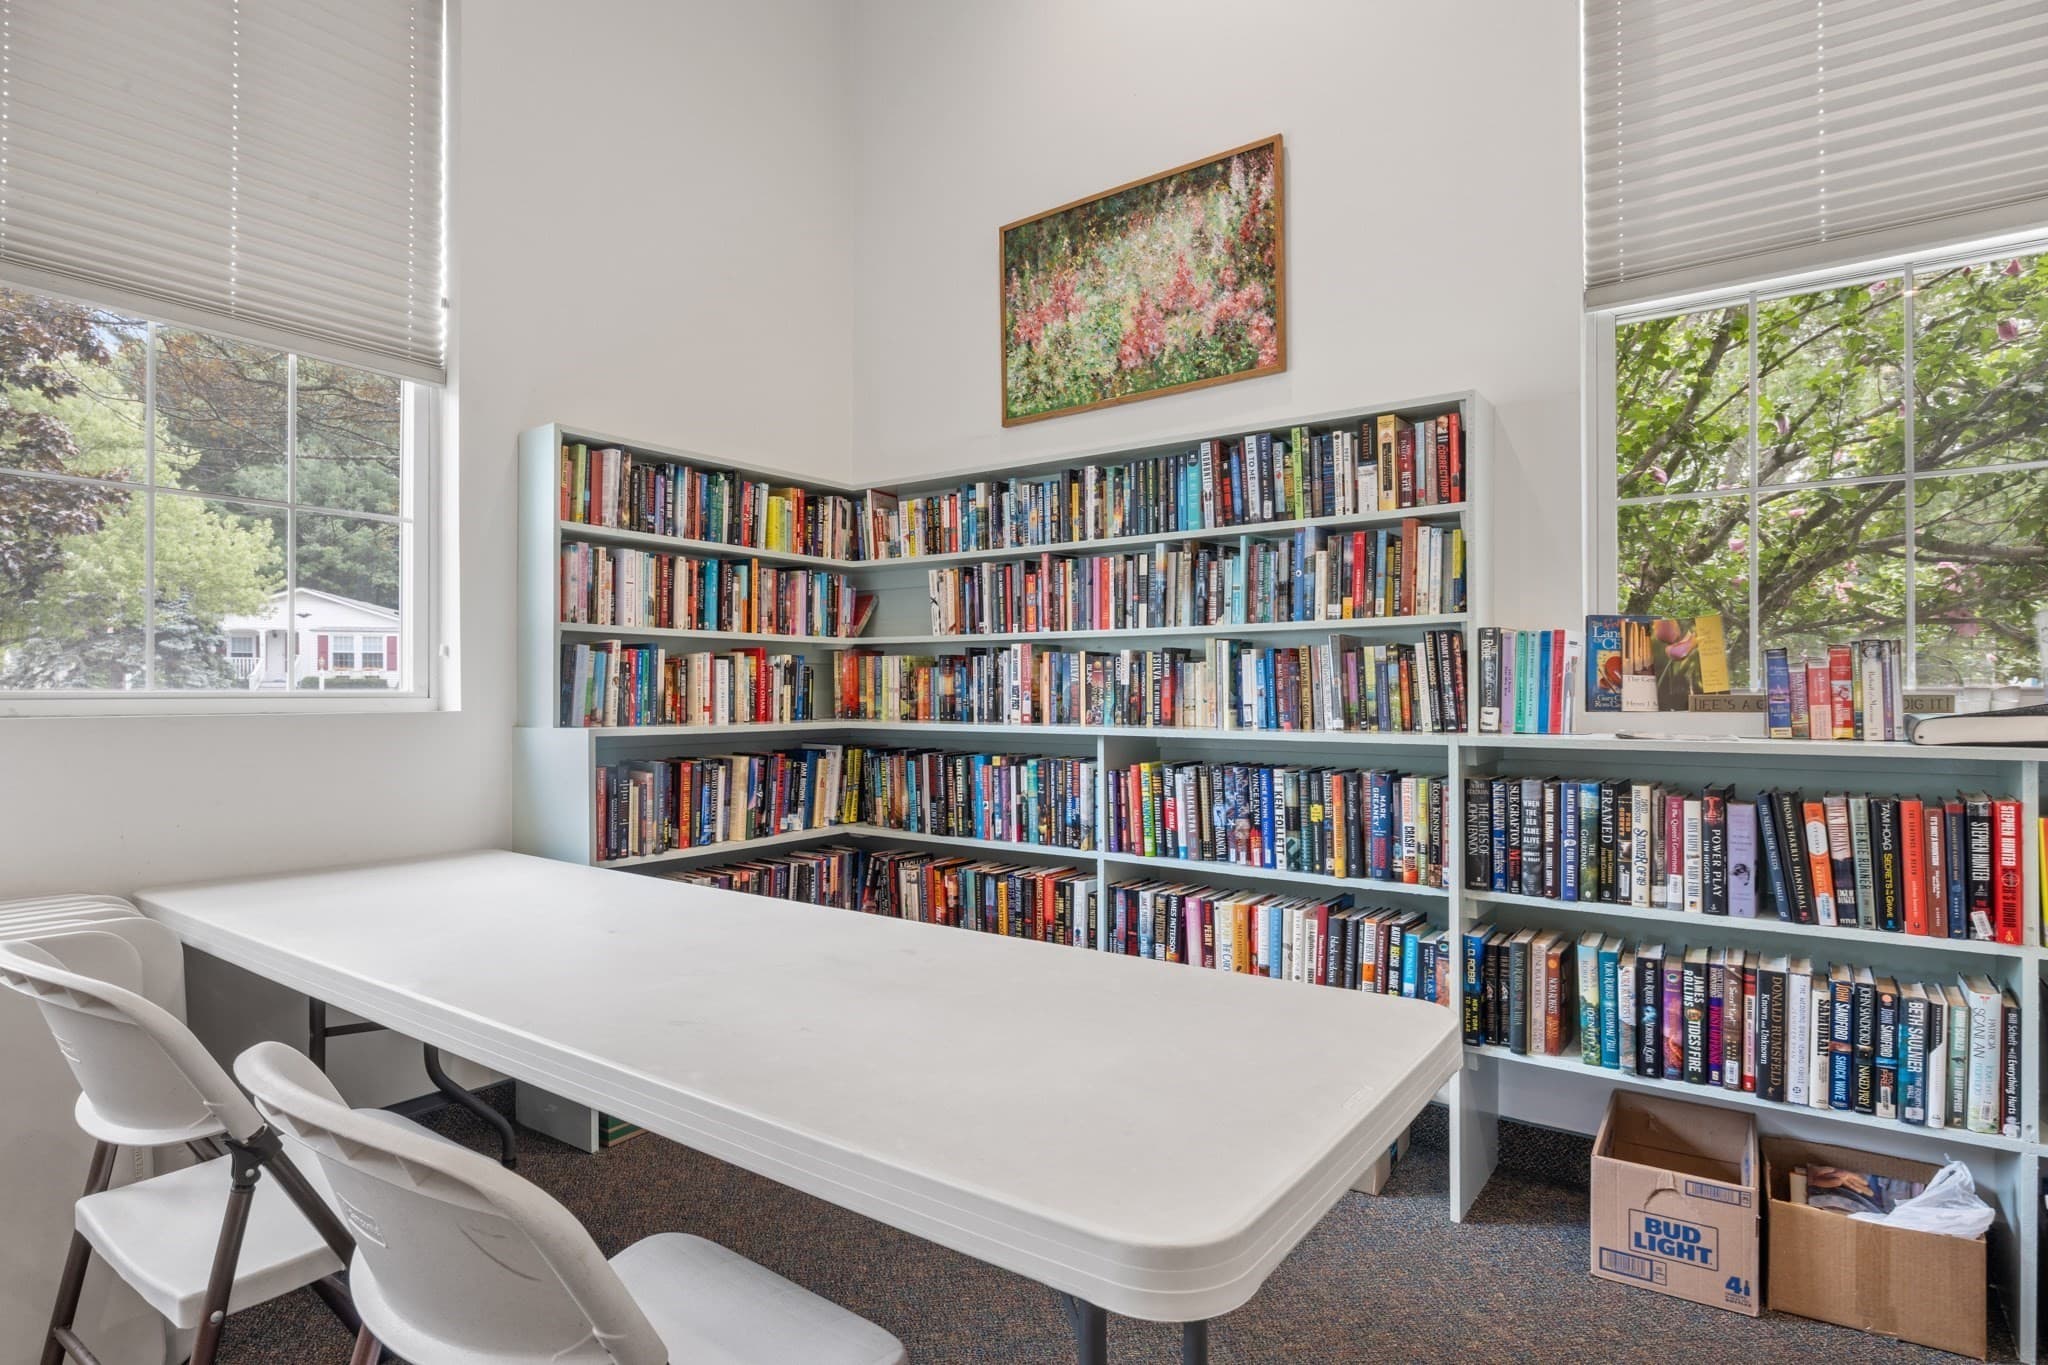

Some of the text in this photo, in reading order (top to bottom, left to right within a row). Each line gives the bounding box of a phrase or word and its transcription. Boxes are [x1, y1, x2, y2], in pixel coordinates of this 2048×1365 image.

[1250, 469, 1256, 480] ME
[1437, 445, 1449, 498] CORRECTIONS
[1153, 659, 1161, 680] SILVA
[1443, 660, 1451, 686] WOODS
[1152, 776, 1162, 794] JAMES
[1165, 768, 1175, 810] CATCH KILL
[1373, 787, 1381, 827] GREANEY
[1431, 783, 1442, 847] ROSE KENNEDY
[1478, 803, 1489, 818] THE
[1493, 797, 1506, 832] GRAFTON
[1509, 785, 1521, 847] SUE GRAFTON
[1523, 800, 1541, 808] WHEN
[1525, 809, 1538, 817] THE
[1566, 789, 1576, 838] MARTHA GRIMES
[1601, 788, 1613, 844] FRAMED
[2000, 805, 2015, 836] STEPHEN
[1275, 791, 1285, 856] KEN FOLLETT
[1404, 826, 1416, 848] CRASH
[1467, 801, 1480, 857] JOHN LENNON
[1478, 821, 1489, 844] LIVES
[1522, 836, 1541, 845] ALIVE
[1523, 827, 1541, 835] CAME
[1880, 802, 1892, 850] TAMI HOAG
[1479, 845, 1490, 857] OF
[1580, 829, 1590, 871] GUARDIANS
[1588, 845, 1596, 857] THE
[1634, 828, 1649, 865] SUMMER
[1668, 819, 1680, 874] Queen's Governess
[1767, 837, 1775, 850] HER
[1769, 851, 1779, 871] NEEDS
[1782, 797, 1805, 910] THOMAS HARRIS HANNIBAL
[1855, 823, 1871, 891] THE KITE RUNNER
[1970, 822, 1990, 881] STEPHEN HUNTER
[2000, 838, 2016, 867] HUNTER
[1566, 849, 1576, 888] FOUL MATTER
[1703, 840, 1711, 885] TIM HIGGINS
[1711, 829, 1722, 898] POWER PLAY
[1775, 881, 1784, 902] HARLEY
[1883, 853, 1895, 918] SECRETS GRAVE
[1169, 896, 1178, 954] JAMES PATTERSON
[1204, 925, 1213, 947] PERRY
[1391, 926, 1401, 946] KATHY
[1327, 936, 1339, 984] black widows
[1391, 947, 1401, 967] REICHS
[1467, 958, 1477, 984] ROBB
[1426, 968, 1435, 994] ATLAS
[1513, 968, 1524, 993] ROBERTS
[1645, 969, 1655, 983] NORA
[1683, 970, 1695, 1008] ROLLINS
[1694, 975, 1705, 1004] JAMES
[1465, 996, 1473, 1033] TO DALLAS
[1471, 999, 1479, 1031] NEW YORK
[1586, 1007, 1598, 1046] IDENTITY
[1760, 994, 1770, 1065] Known Unknown
[1799, 997, 1807, 1025] WEDDING
[1835, 983, 1851, 1041] JOHN SANDFORD
[1859, 986, 1871, 1047] JOHN SANDFORD
[1688, 1021, 1702, 1073] TIDES FIRE
[1709, 1006, 1723, 1065] FIRST OFFENSE
[1769, 976, 1784, 1085] DONALD RUMSFELD
[1880, 1007, 1895, 1058] JOHN SANDFORD
[1907, 1002, 1924, 1073] BETH SAULNIER
[1973, 1007, 1986, 1059] SCANLAN
[1987, 1018, 1997, 1050] PATRICIA
[1834, 1055, 1847, 1101] SHOCK WAVE
[2004, 1012, 2019, 1115] Bill Scheft Everything Hurts
[1858, 1065, 1871, 1106] NAKED PREY
[1907, 1084, 1915, 1100] WALL
[1914, 1088, 1922, 1108] FOURTH
[1634, 1231, 1712, 1264] LIGHT
[1644, 1217, 1702, 1244] BUD
